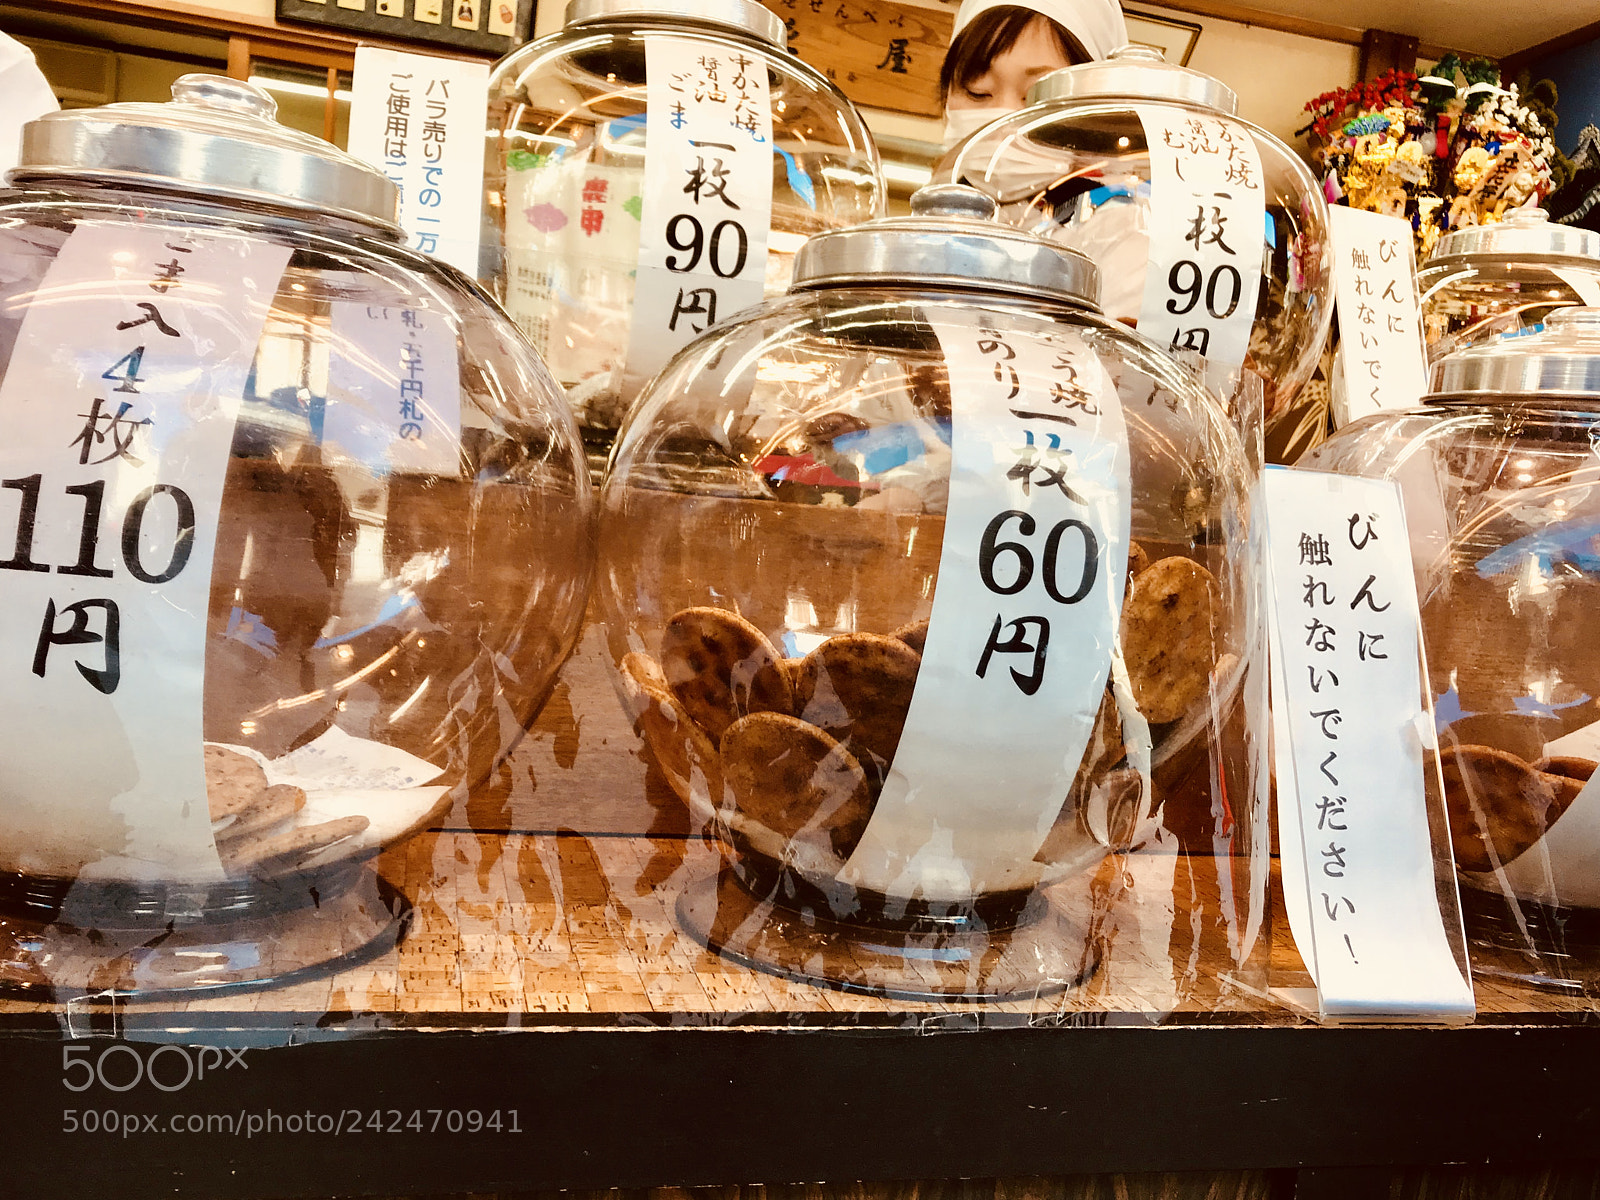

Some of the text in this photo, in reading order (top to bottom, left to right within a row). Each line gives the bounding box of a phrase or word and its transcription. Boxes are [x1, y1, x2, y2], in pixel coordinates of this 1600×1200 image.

[669, 72, 692, 129] ごま
[695, 55, 727, 104] 醤油
[728, 53, 765, 142] 中かた焼
[415, 79, 450, 254] バラ売りでの一万
[665, 139, 748, 334] 一枚 90 円
[1185, 191, 1236, 255] 一枚
[1166, 259, 1242, 320] 90
[1351, 247, 1382, 408] 触れないでく
[1379, 239, 1404, 333] びんに
[0, 473, 196, 584] 110
[975, 407, 1098, 696] 一枚 60 円
[1348, 512, 1391, 662] びんに
[32, 597, 120, 694] 円
[1298, 531, 1359, 966] 触れないでください！
